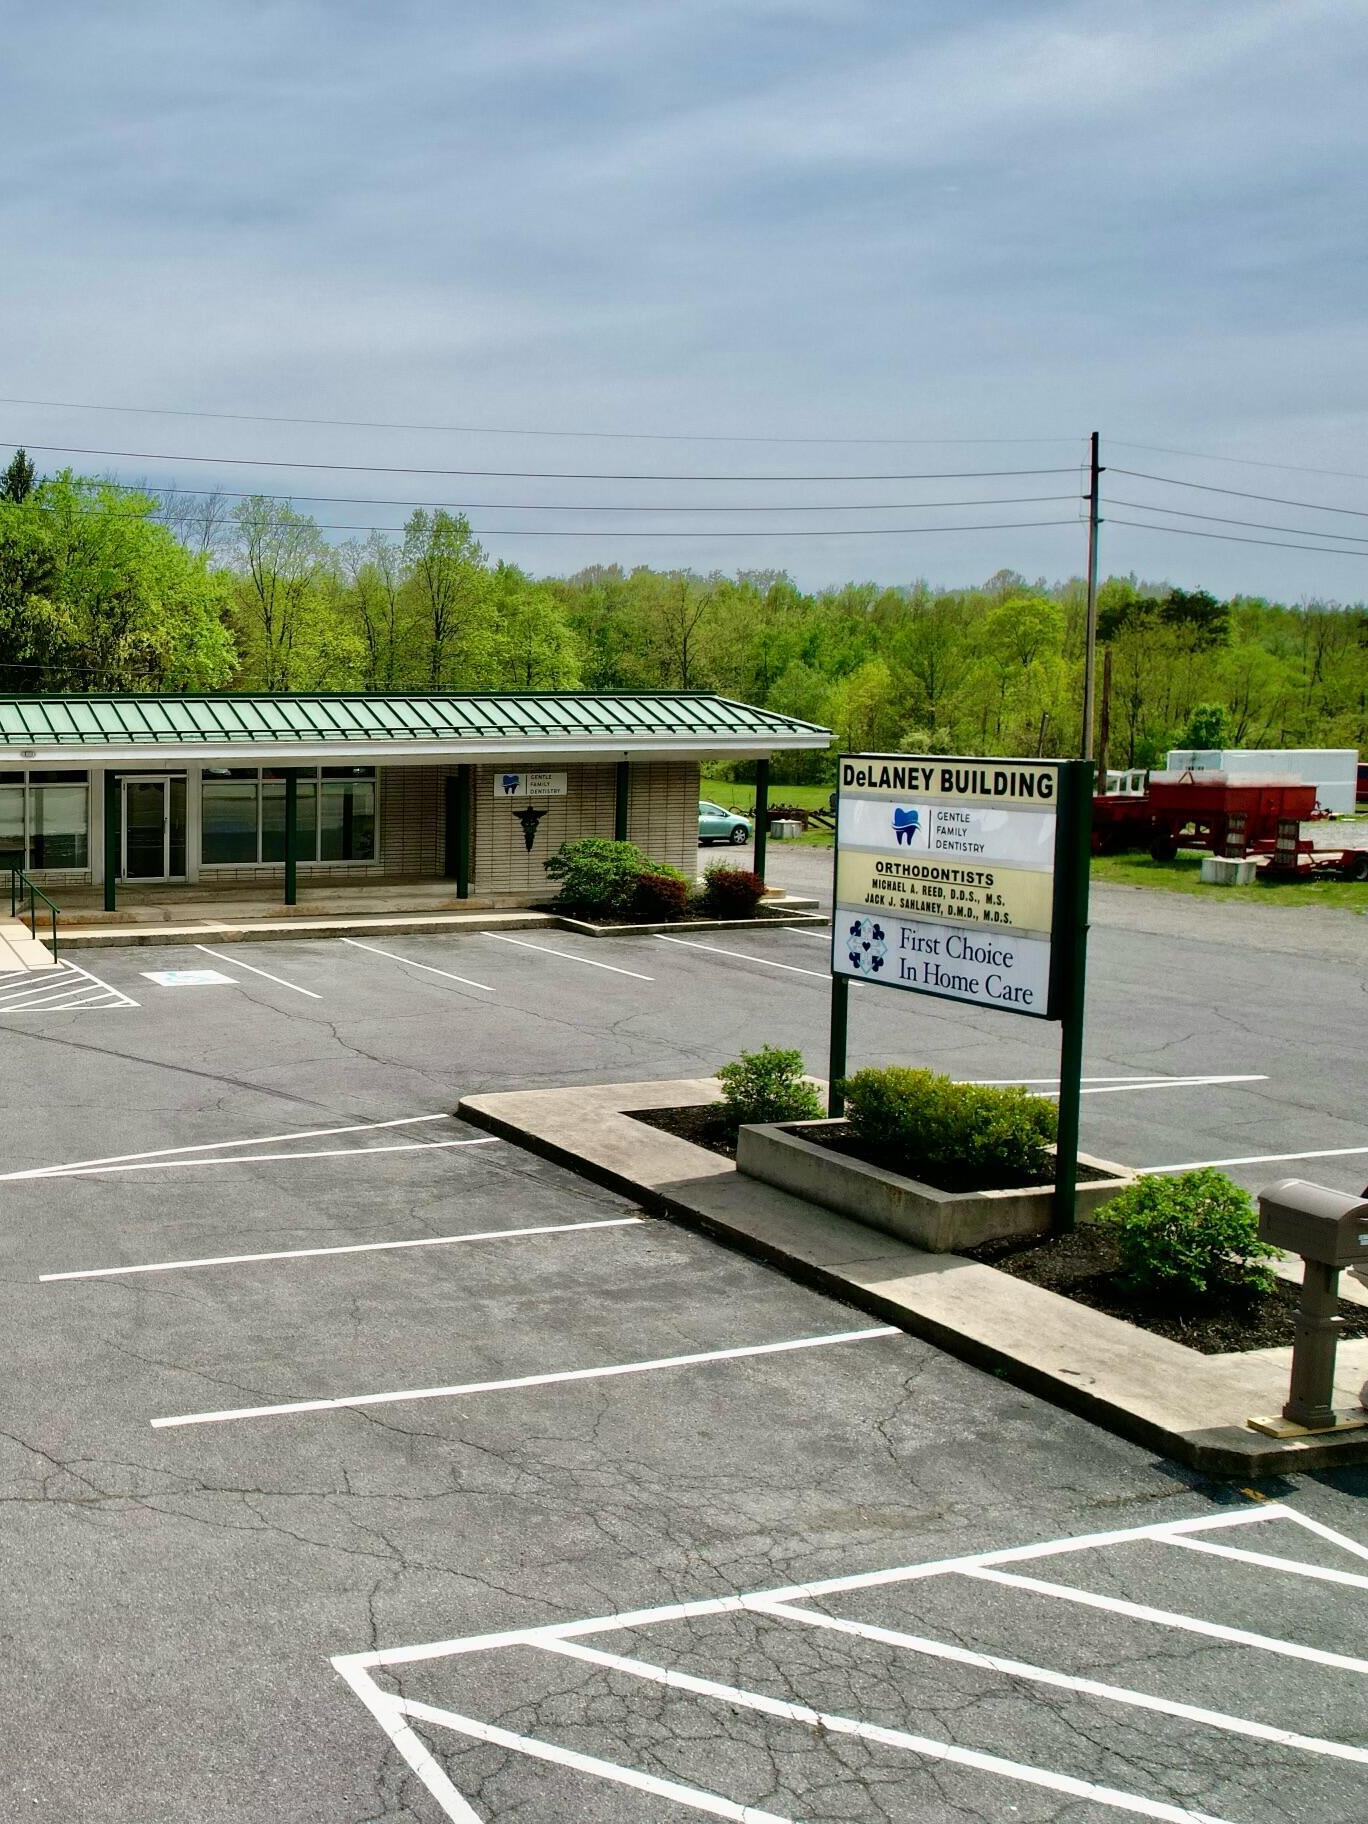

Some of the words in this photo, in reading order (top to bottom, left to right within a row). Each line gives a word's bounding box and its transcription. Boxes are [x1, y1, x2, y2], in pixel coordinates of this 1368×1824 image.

[843, 763, 934, 791] DeLANEY
[940, 768, 1053, 799] BUILDING
[936, 811, 971, 823] GENTLE
[936, 825, 968, 837] FAMILY
[935, 839, 985, 853] DENTISTRY
[875, 860, 994, 886] ORTHODONTISTS
[872, 878, 906, 893] MICHAEL
[910, 883, 918, 894] A.
[922, 885, 946, 899] REED,
[950, 889, 980, 904] D.D.S.,
[985, 893, 1005, 906] M.S.
[864, 892, 885, 905] JACK
[888, 896, 896, 907] J.
[900, 898, 944, 916] SAHLANEY,
[948, 905, 979, 921] D.M.D.,
[983, 910, 1013, 925] M.D.S.
[899, 926, 941, 955] First
[946, 935, 1014, 968] Choice
[899, 957, 918, 981] In
[922, 961, 979, 994] Home
[985, 974, 1034, 1005] Care
